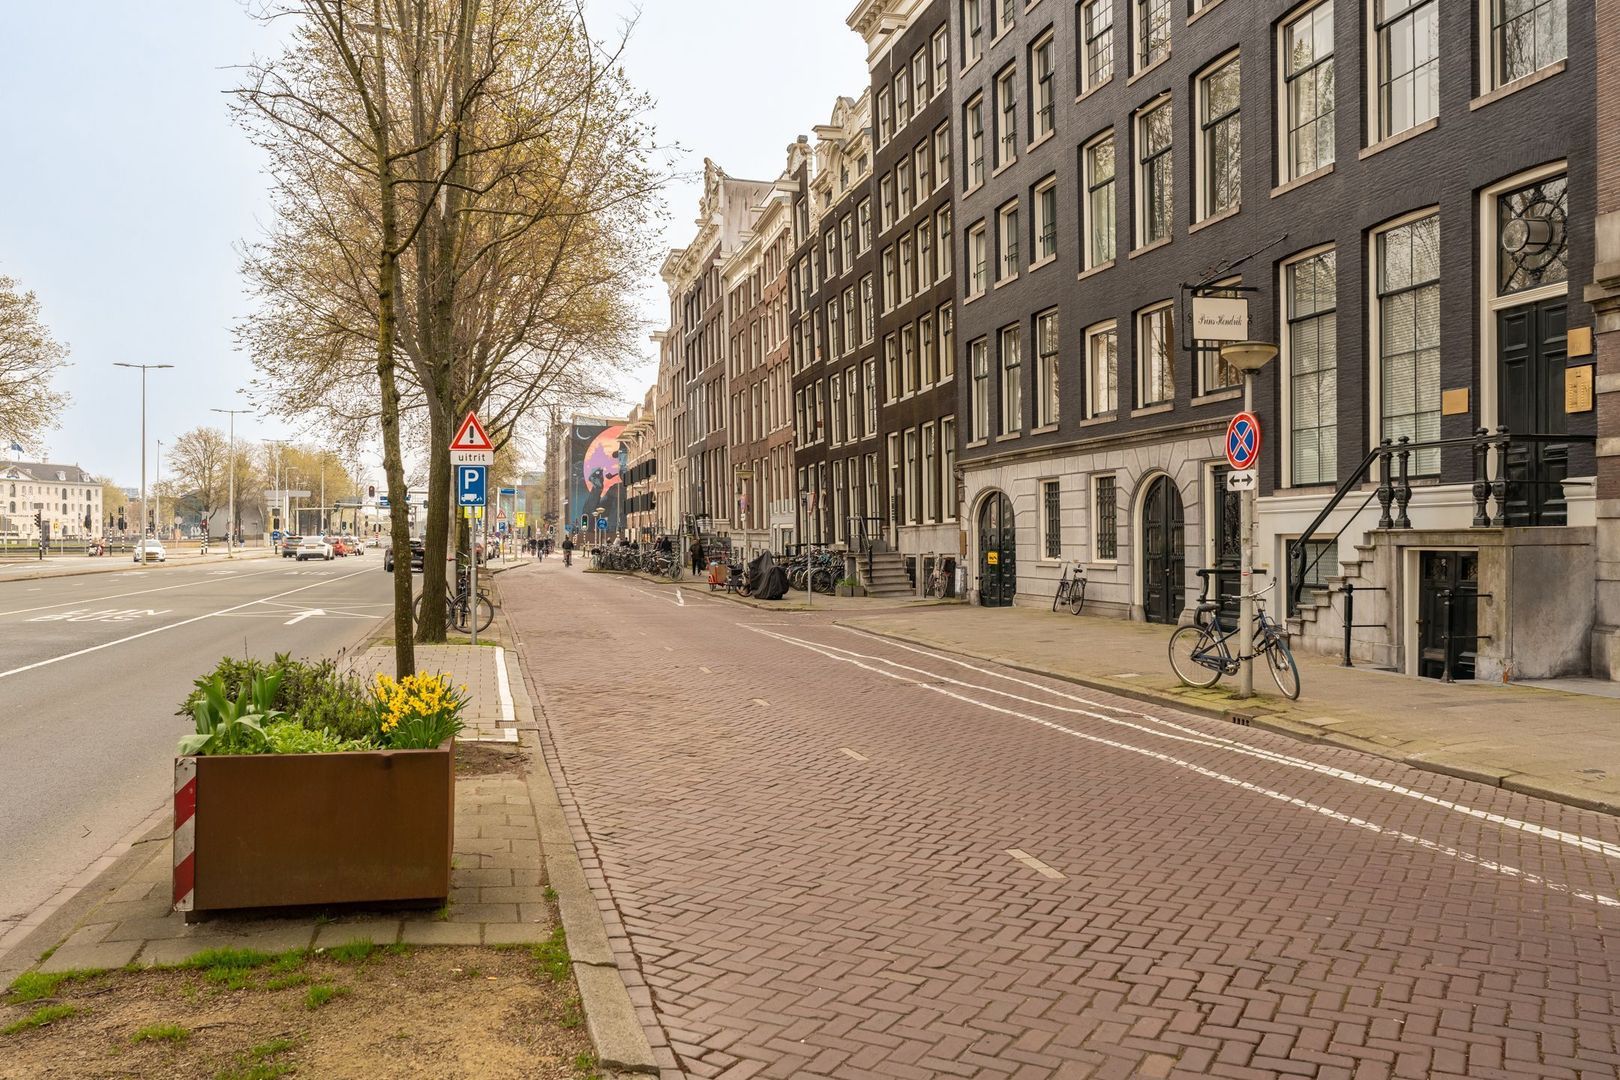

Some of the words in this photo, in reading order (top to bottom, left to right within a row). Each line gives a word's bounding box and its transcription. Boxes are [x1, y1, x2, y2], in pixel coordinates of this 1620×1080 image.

[1216, 313, 1242, 326] Hendrik
[458, 453, 486, 462] uitrit
[464, 469, 479, 489] P
[23, 614, 142, 622] BUS
